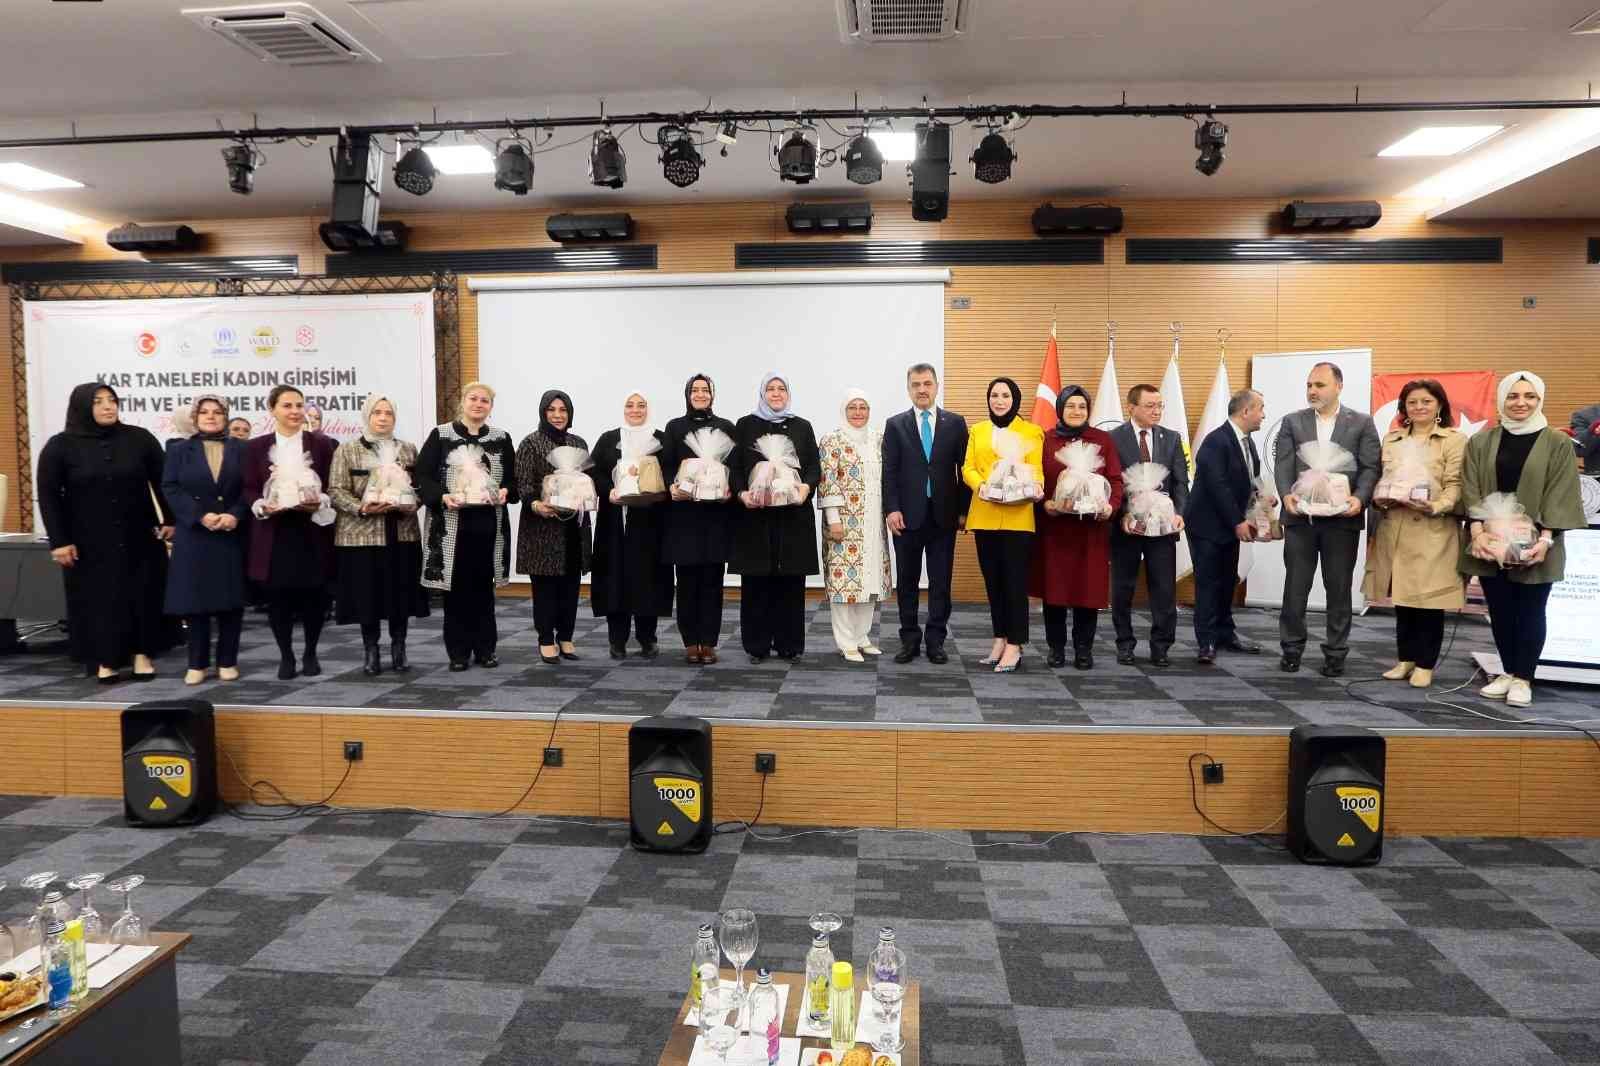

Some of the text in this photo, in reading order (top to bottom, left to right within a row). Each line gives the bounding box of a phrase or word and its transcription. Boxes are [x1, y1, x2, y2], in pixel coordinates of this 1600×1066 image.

[96, 367, 357, 390] KAR TANELERİ KADIN GİRİŞİMİ
[151, 397, 174, 412] VE
[147, 765, 185, 777] 1000
[658, 788, 696, 800] 1000
[1341, 797, 1377, 810] 1000
